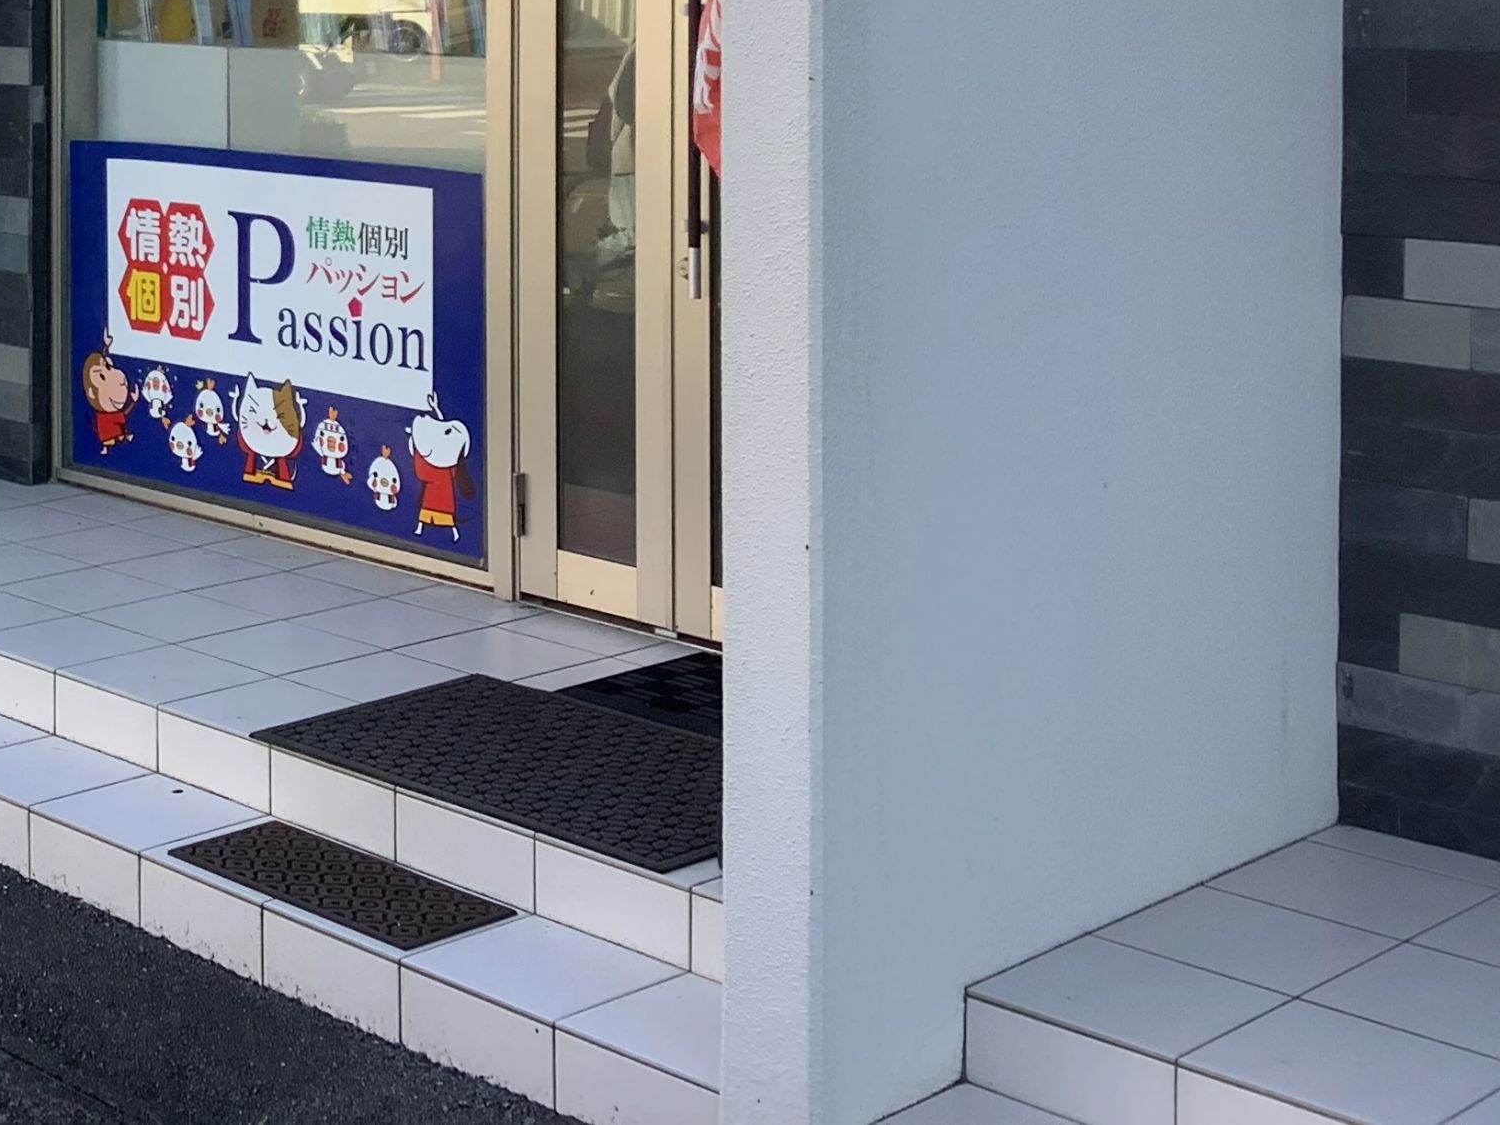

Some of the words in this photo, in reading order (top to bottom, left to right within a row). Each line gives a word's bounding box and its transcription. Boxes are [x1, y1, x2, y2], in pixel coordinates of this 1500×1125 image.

[125, 206, 207, 268] 情熱
[306, 215, 410, 261] 情熱個別
[126, 269, 206, 332] 個別
[227, 210, 430, 373] Passion
[306, 257, 426, 304] パッション
